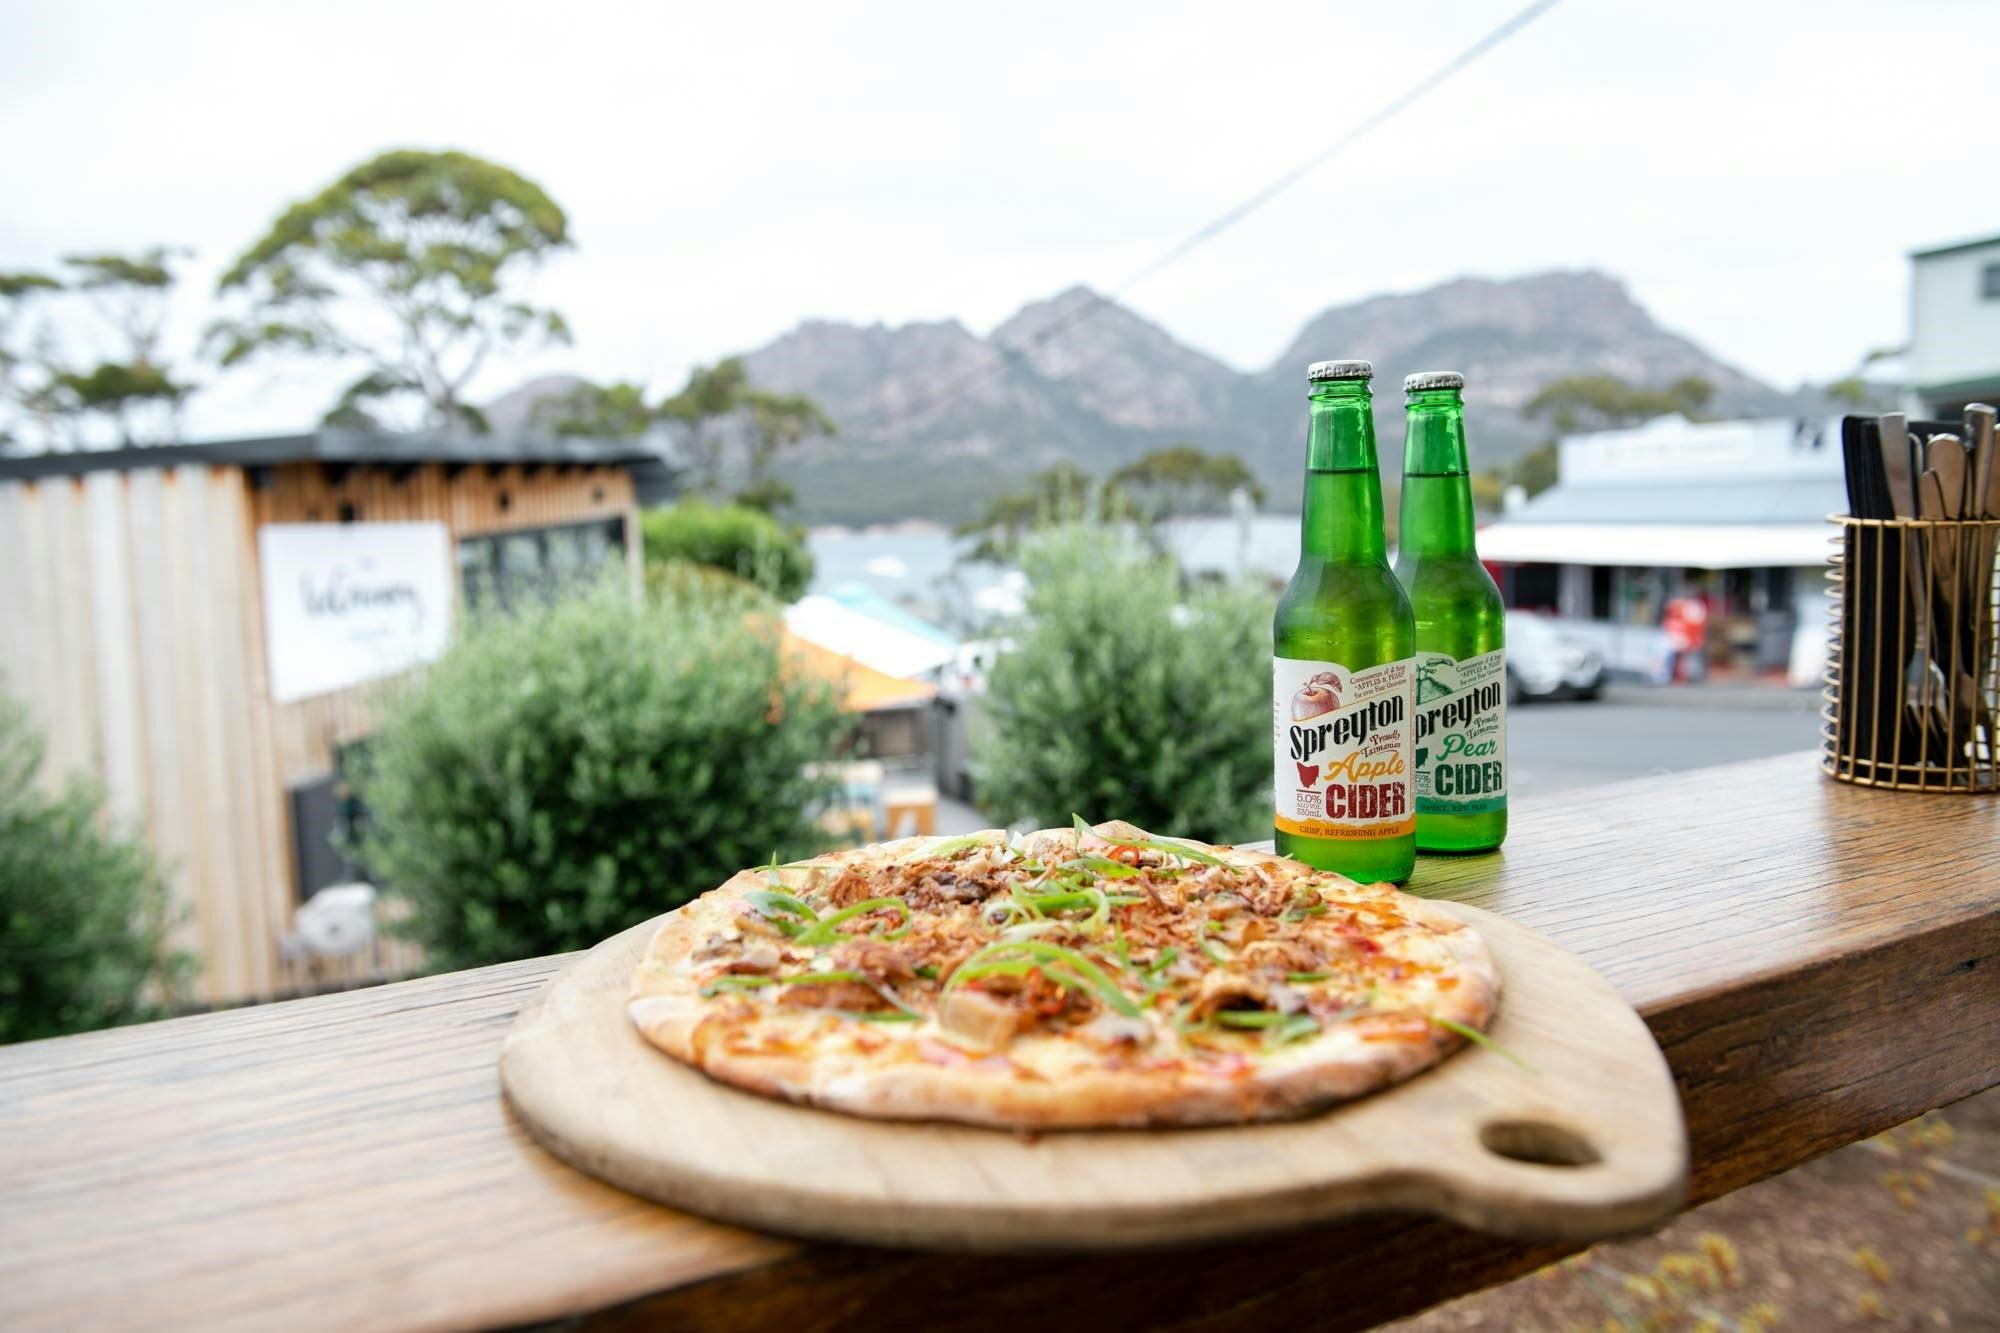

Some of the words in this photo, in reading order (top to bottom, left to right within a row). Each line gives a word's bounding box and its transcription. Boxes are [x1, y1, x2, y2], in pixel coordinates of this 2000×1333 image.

[1416, 682, 1500, 745] preyton
[1289, 695, 1404, 762] Spreyton
[1369, 730, 1400, 745] Proudly
[1361, 742, 1401, 758] Tasmanian
[1436, 733, 1497, 761] Pear
[1324, 751, 1406, 782] Apple
[1435, 760, 1502, 796] CIDER
[1296, 793, 1321, 804] 5.0%
[1326, 781, 1405, 819] CIDER
[1299, 825, 1322, 836] CRISP,
[1325, 828, 1376, 836] REFRESHING
[1379, 826, 1400, 835] APPLE
